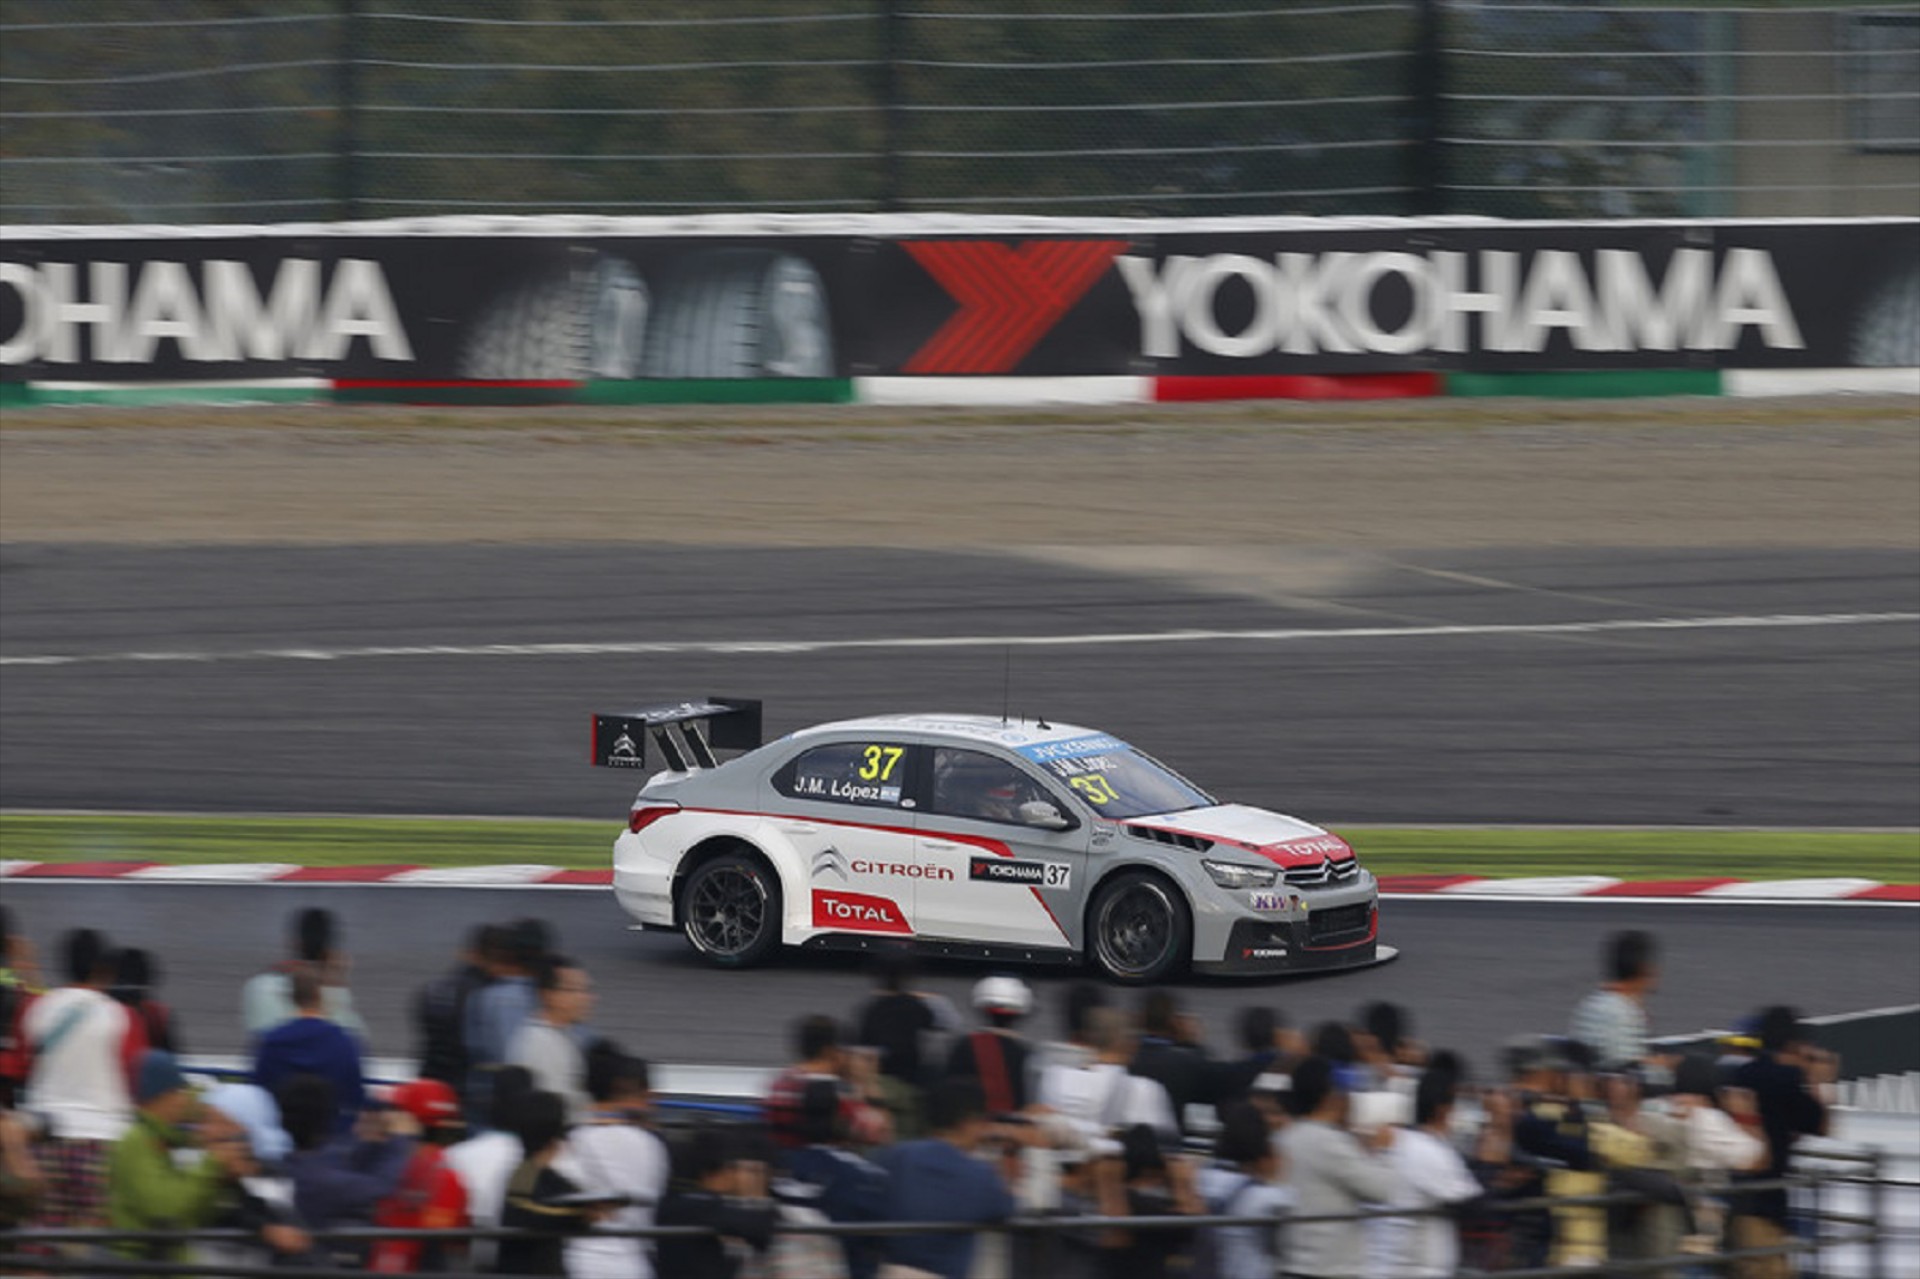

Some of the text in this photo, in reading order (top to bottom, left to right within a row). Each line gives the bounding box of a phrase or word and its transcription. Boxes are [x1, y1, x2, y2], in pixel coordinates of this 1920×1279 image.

[1111, 248, 1806, 359] YOKOHAMA
[859, 745, 904, 781] 37
[793, 776, 879, 802] J.M. López
[1070, 773, 1120, 805] 37
[988, 864, 1042, 879] YOKOHAMA
[1047, 865, 1070, 885] 37
[822, 899, 895, 923] TOTAL
